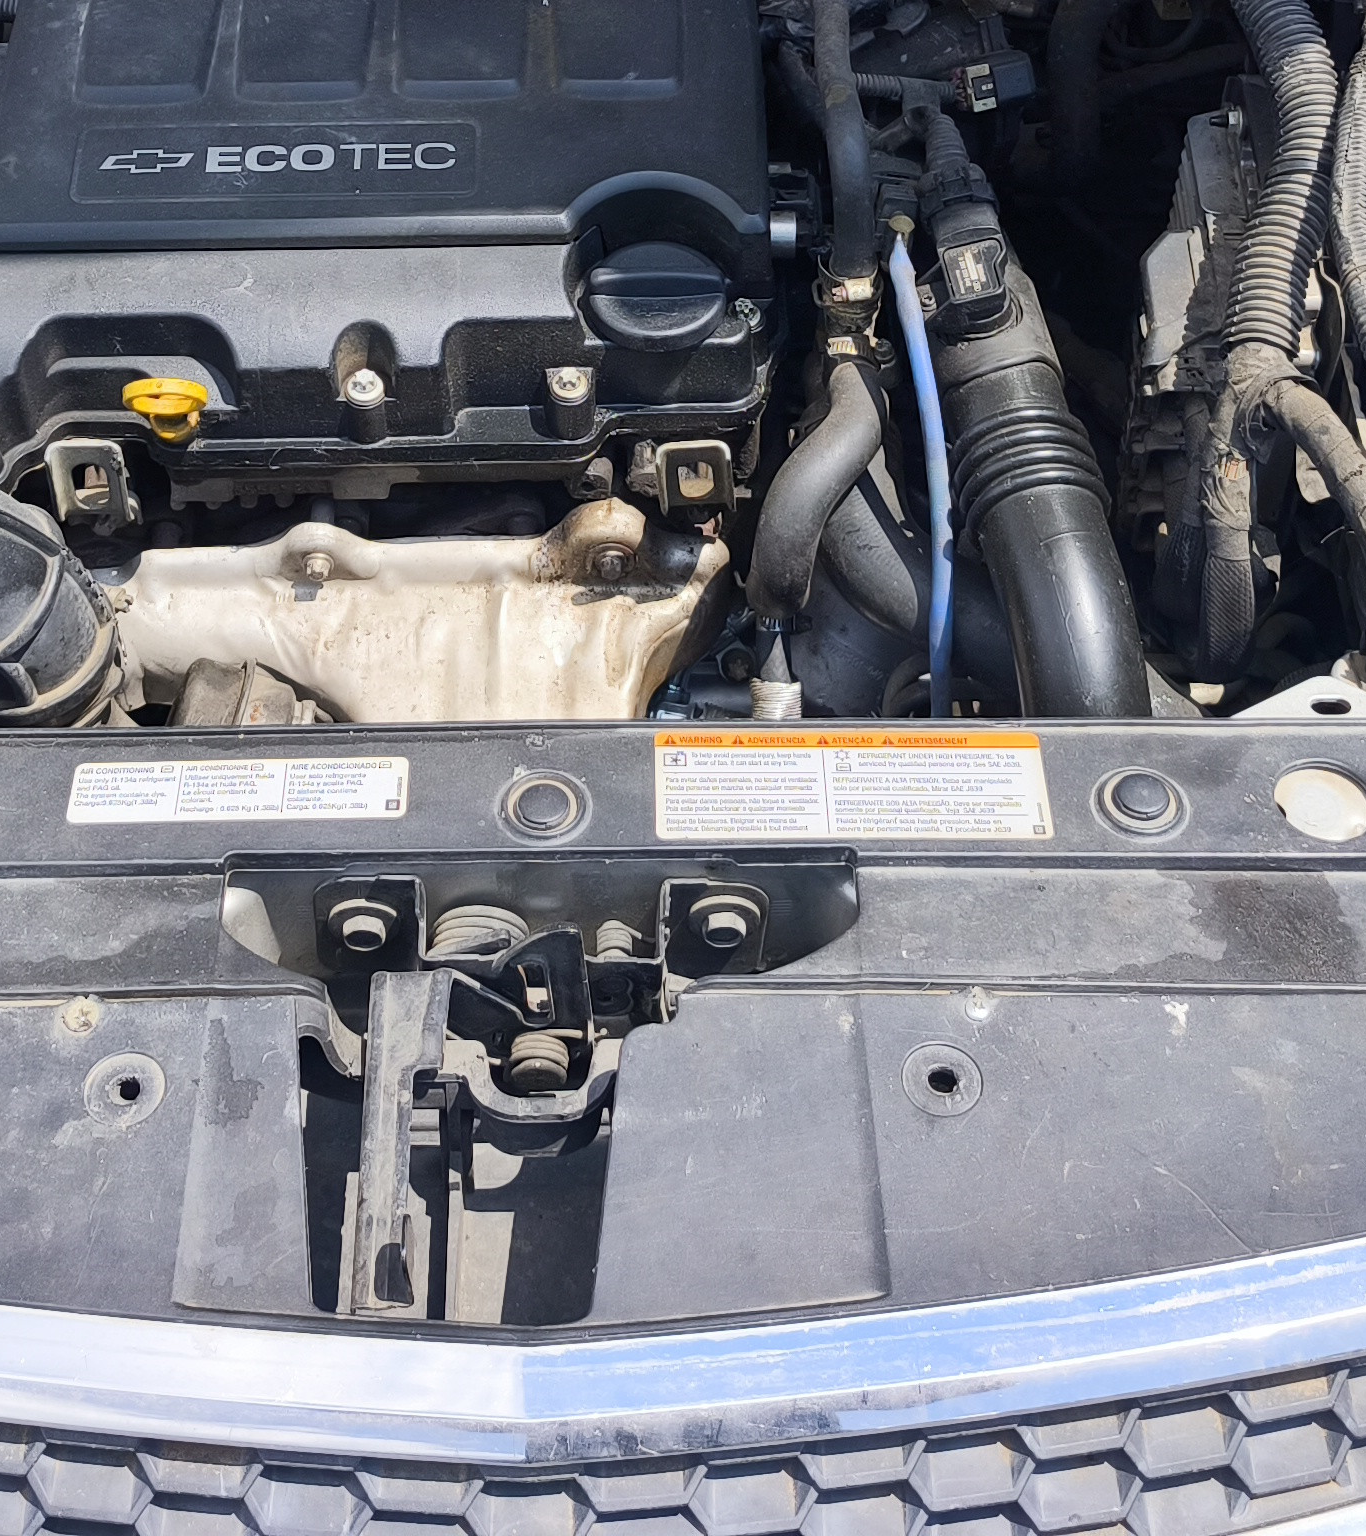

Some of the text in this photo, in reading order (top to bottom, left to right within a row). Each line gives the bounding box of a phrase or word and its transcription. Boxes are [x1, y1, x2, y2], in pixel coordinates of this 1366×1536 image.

[205, 142, 457, 173] ECOTEC
[832, 736, 873, 745] ATENÇÃO
[80, 766, 154, 775] AIR CONDITIONING
[311, 762, 376, 770] ACONDICIONADO
